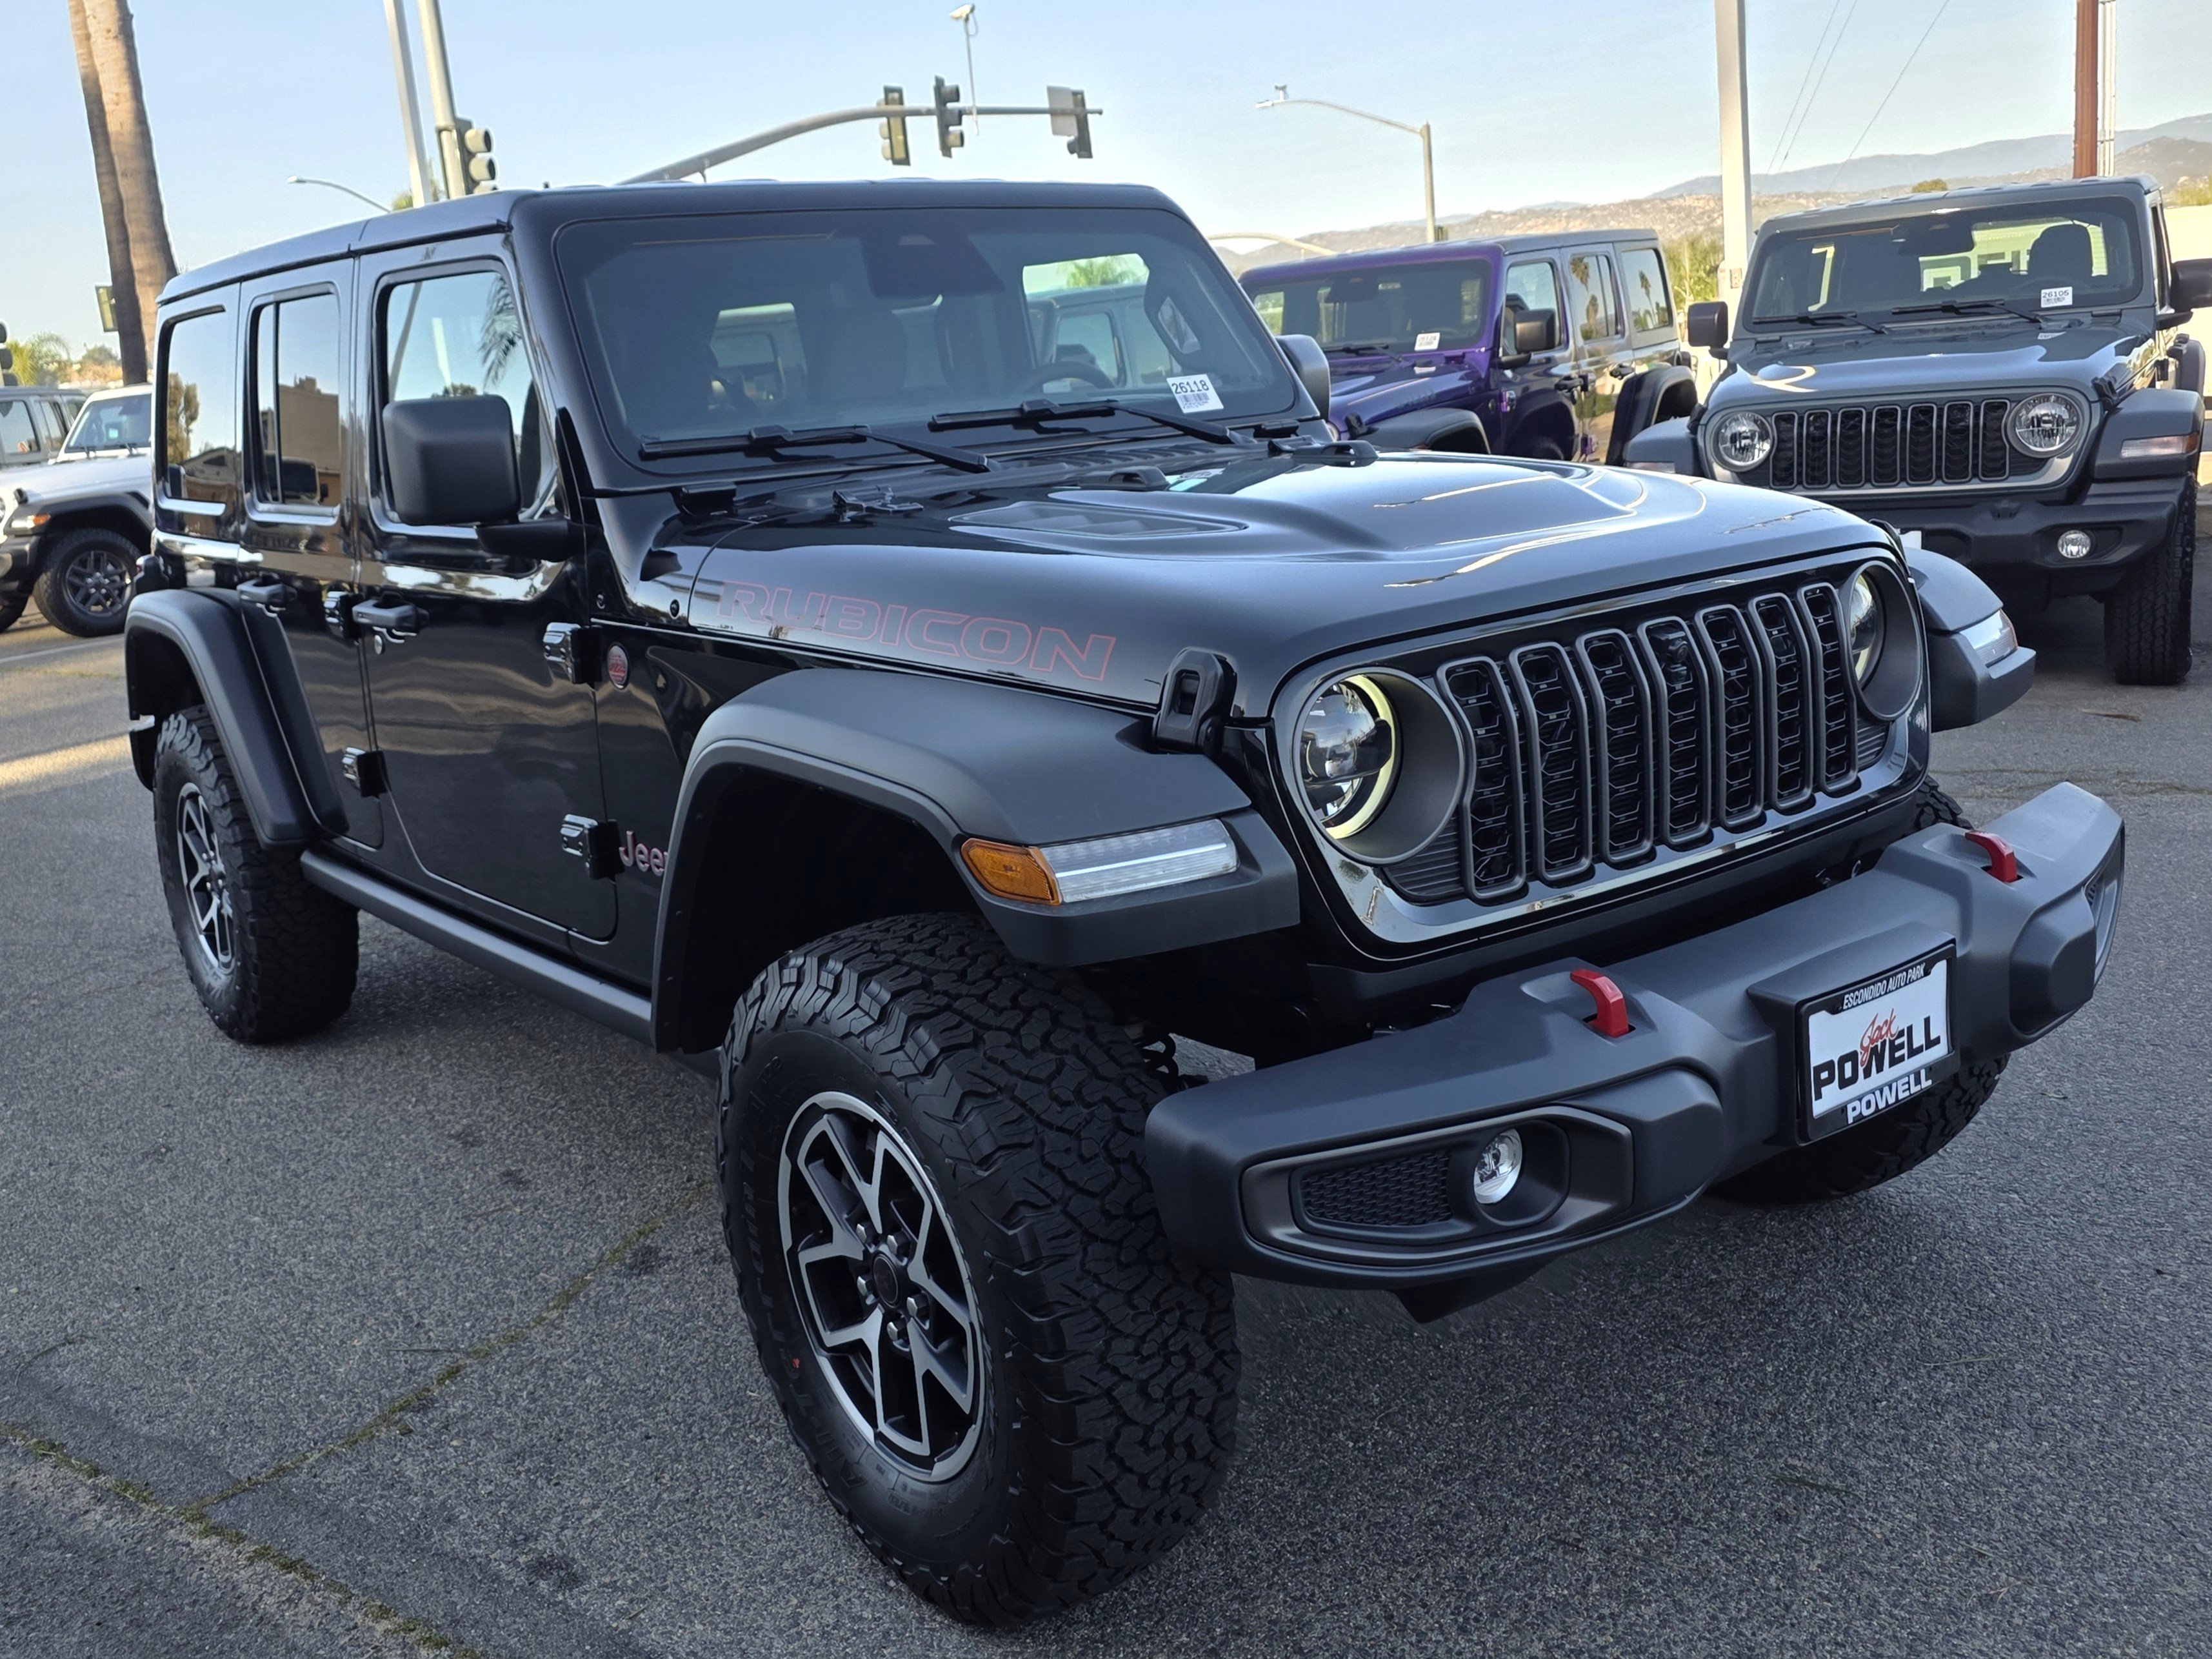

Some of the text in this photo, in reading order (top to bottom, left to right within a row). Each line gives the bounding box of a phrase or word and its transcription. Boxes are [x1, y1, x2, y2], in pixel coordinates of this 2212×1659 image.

[2042, 290, 2069, 298] 26105
[1171, 379, 1209, 394] 26118
[716, 581, 1116, 680] RUBICON
[1843, 963, 1926, 1009] ESCONDIDO AUTO PARK
[1813, 1015, 1941, 1101] POWELL
[1860, 1008, 1899, 1067] Jack
[1846, 1069, 1932, 1124] POWELL
